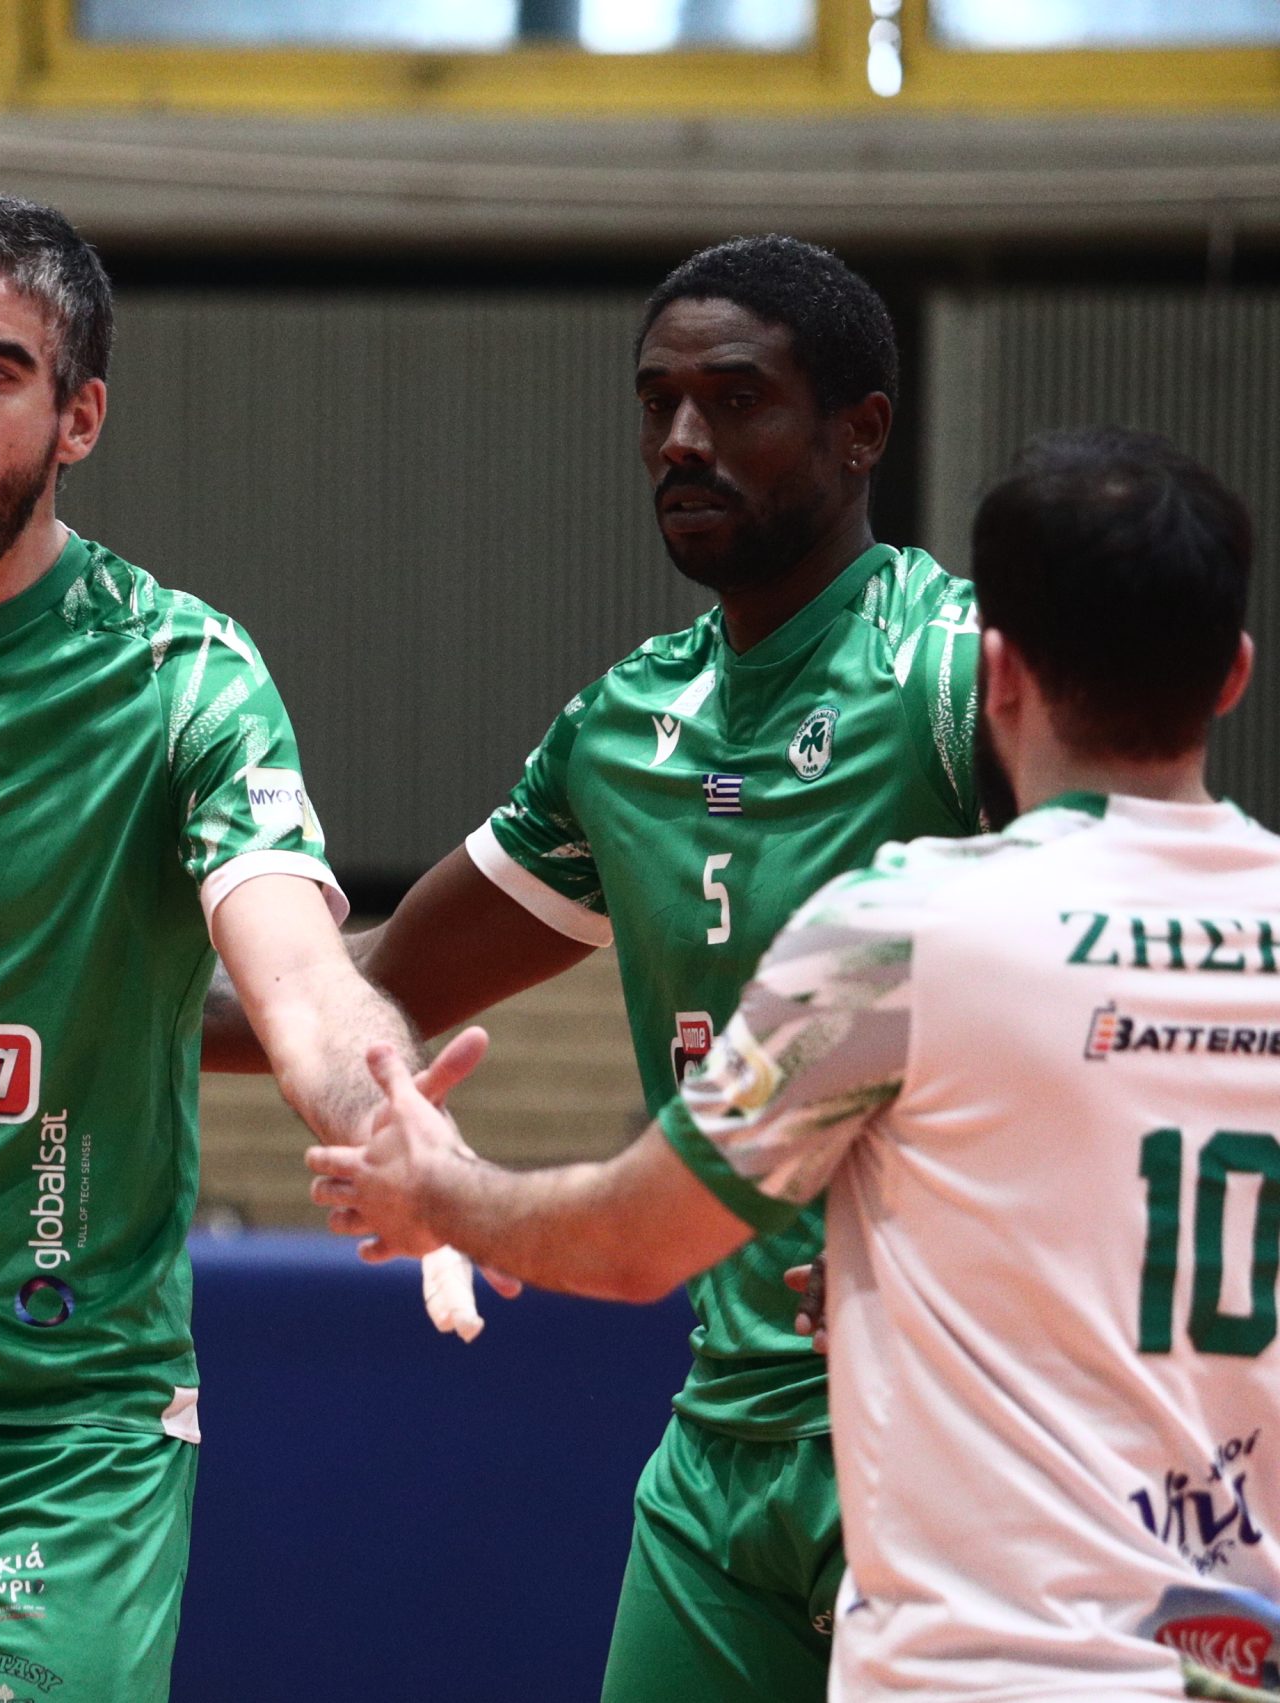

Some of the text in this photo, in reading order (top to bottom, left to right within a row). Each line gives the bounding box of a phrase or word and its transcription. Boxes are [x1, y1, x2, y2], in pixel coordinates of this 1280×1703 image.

[703, 852, 732, 945] 5
[28, 1108, 70, 1269] globalsat
[77, 1134, 91, 1248] FULL OF TECH SENSES
[1138, 1127, 1280, 1358] 10
